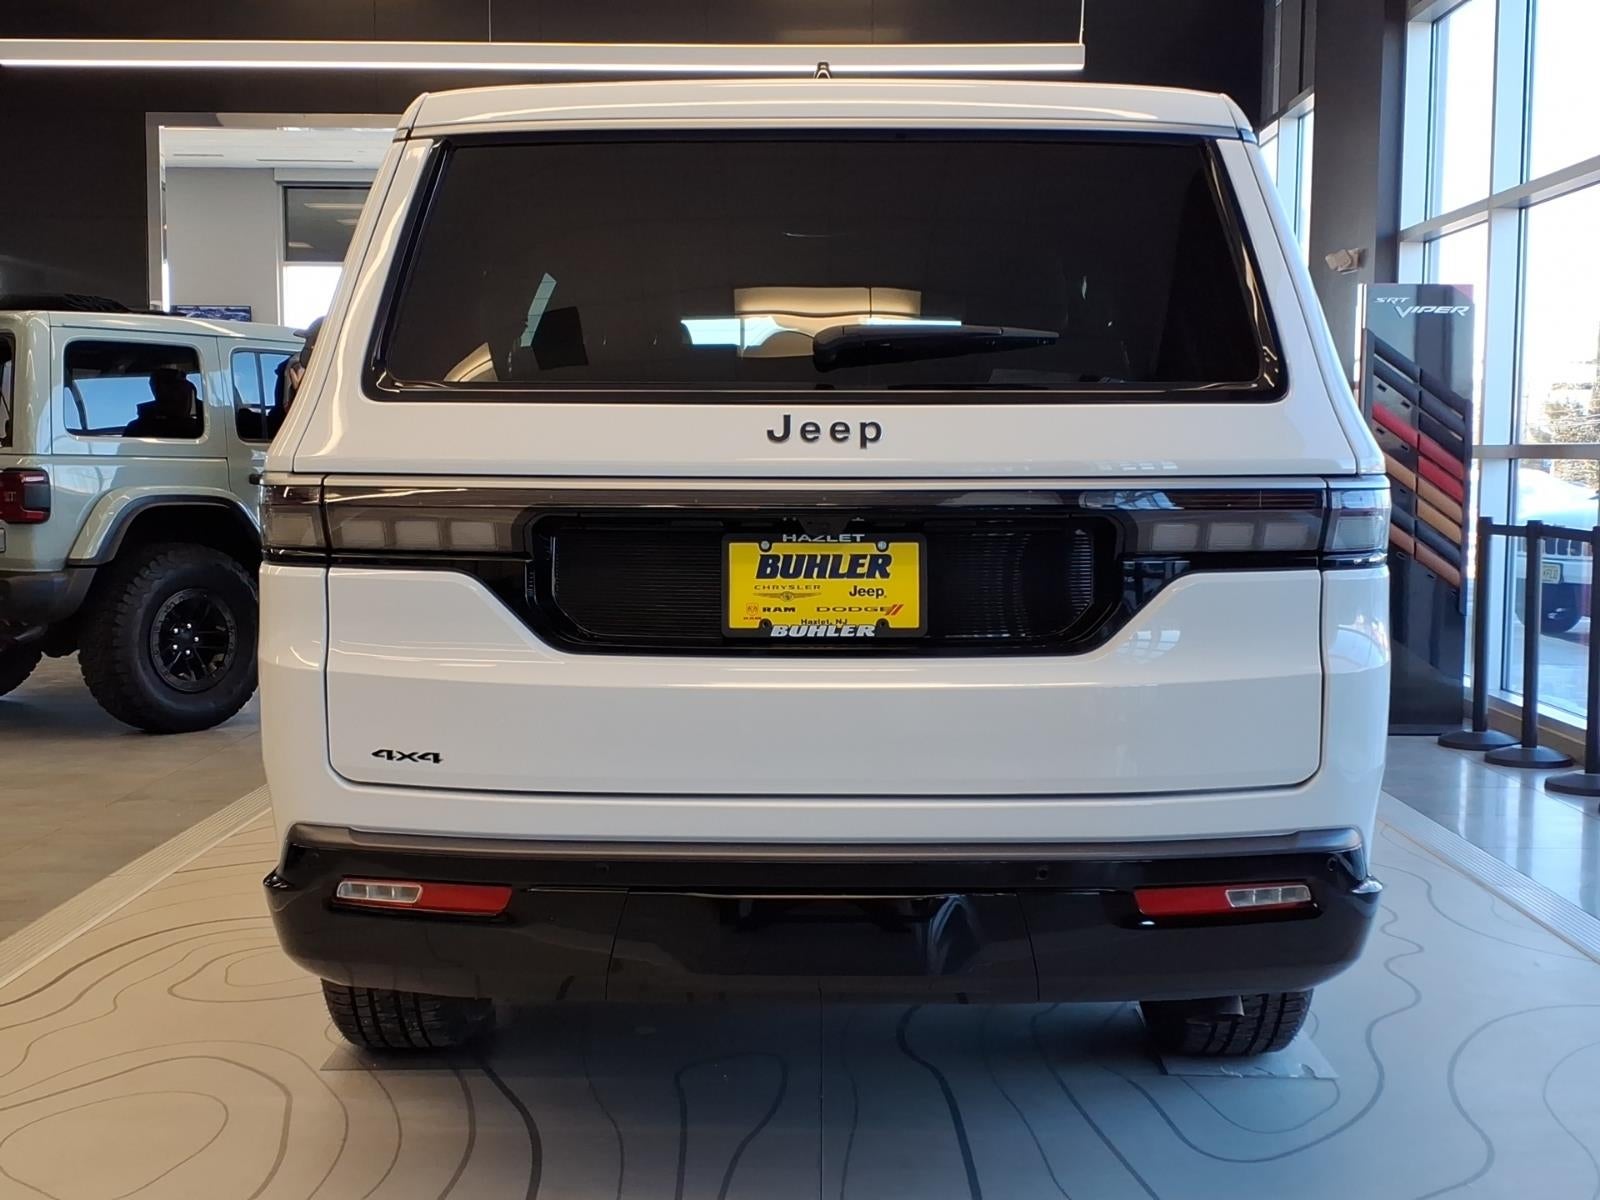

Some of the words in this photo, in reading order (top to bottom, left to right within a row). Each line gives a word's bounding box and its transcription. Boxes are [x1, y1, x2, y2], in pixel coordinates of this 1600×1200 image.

[1395, 306, 1470, 318] VIPER
[767, 414, 882, 449] Jeep
[756, 554, 891, 579] BUHLER
[849, 585, 884, 598] Jeep
[770, 625, 876, 637] BUHLER
[371, 749, 443, 764] 4x4
